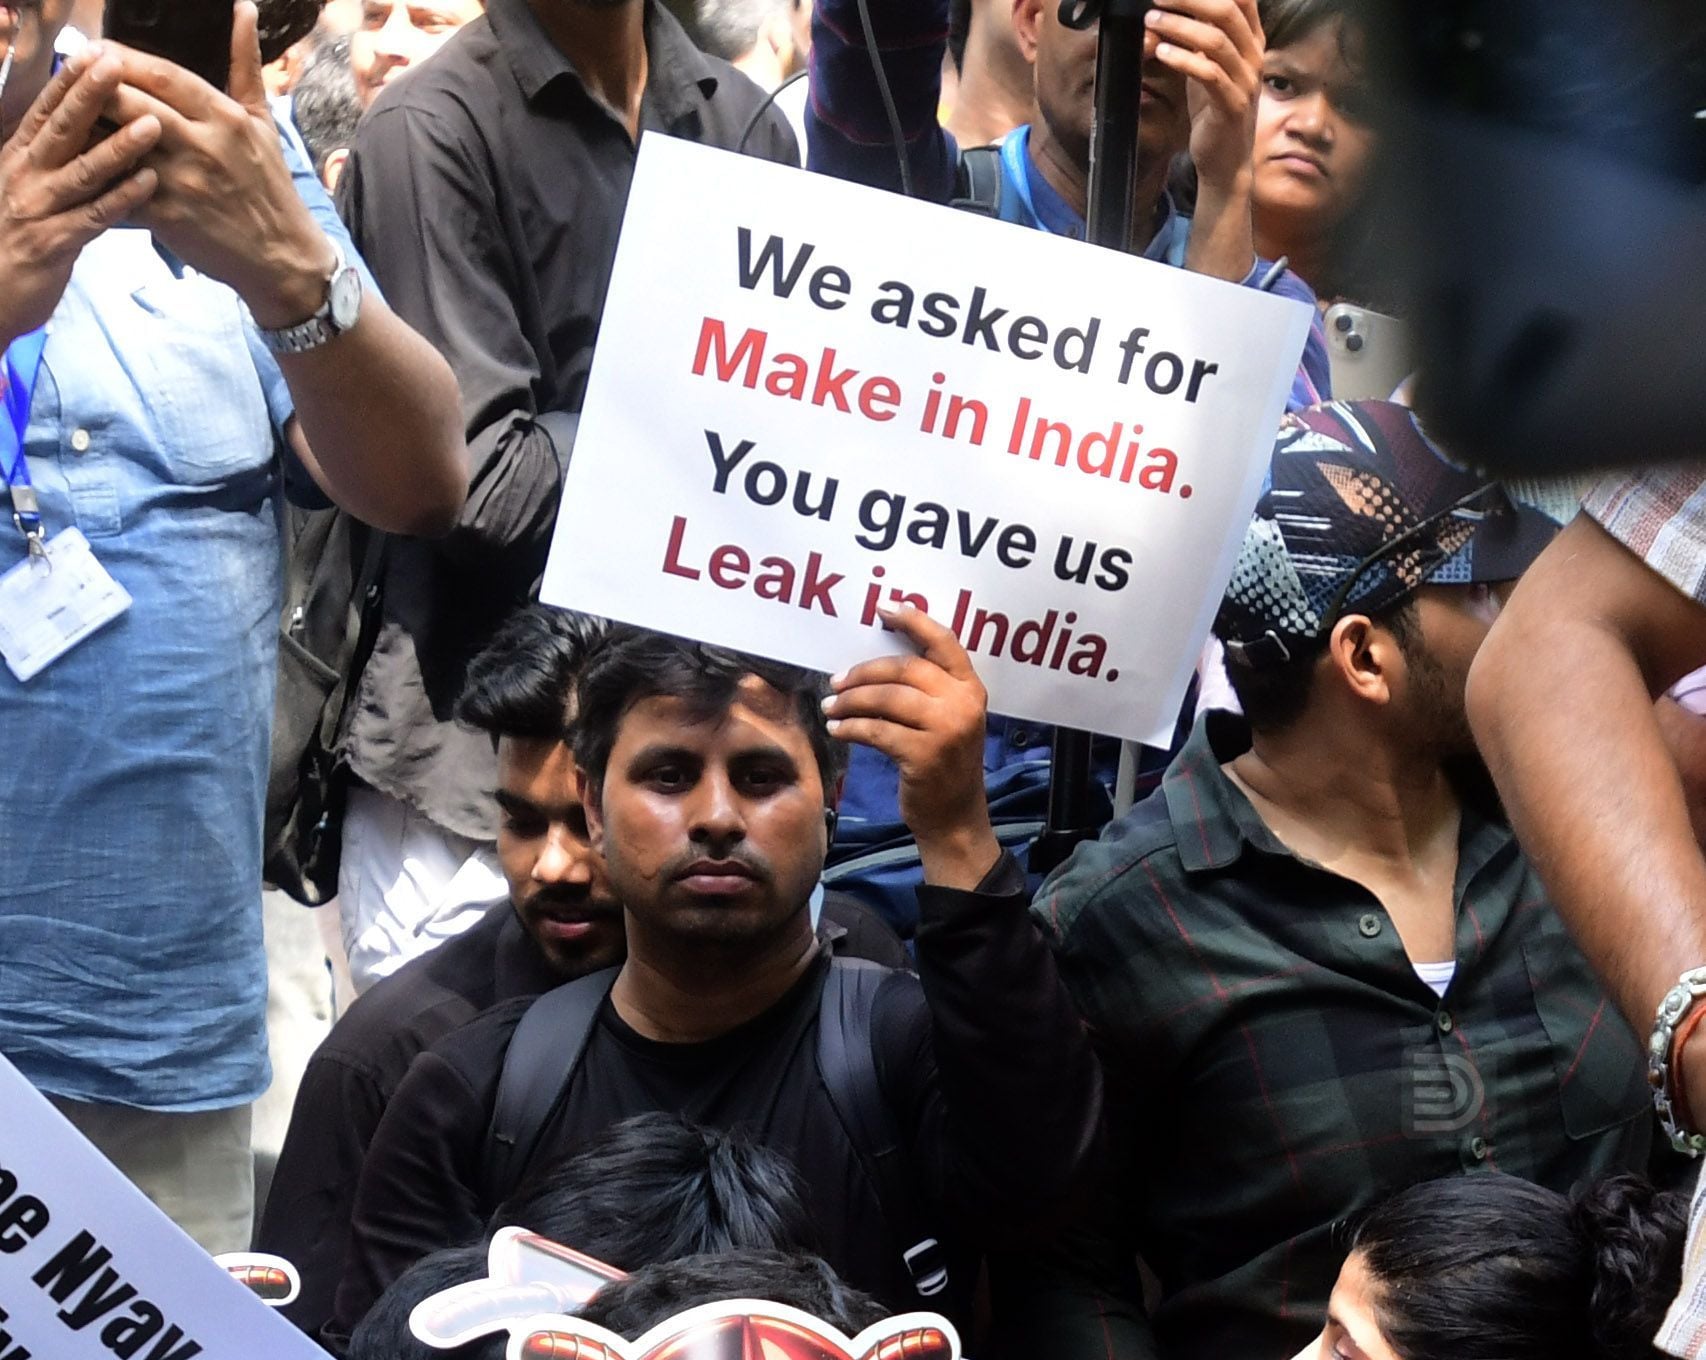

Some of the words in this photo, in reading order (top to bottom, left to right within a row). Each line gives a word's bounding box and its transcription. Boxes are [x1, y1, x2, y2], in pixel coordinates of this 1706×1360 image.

[737, 227, 851, 310] We
[871, 281, 1101, 374] asked
[1118, 325, 1219, 403] for
[692, 317, 901, 422] Make
[921, 372, 988, 446] in
[1007, 396, 1193, 499] India.
[704, 430, 839, 522] You
[855, 489, 1037, 579] gave
[1053, 535, 1133, 592] us
[662, 516, 845, 618] Leak
[860, 566, 929, 629] in
[950, 587, 1120, 683] India.
